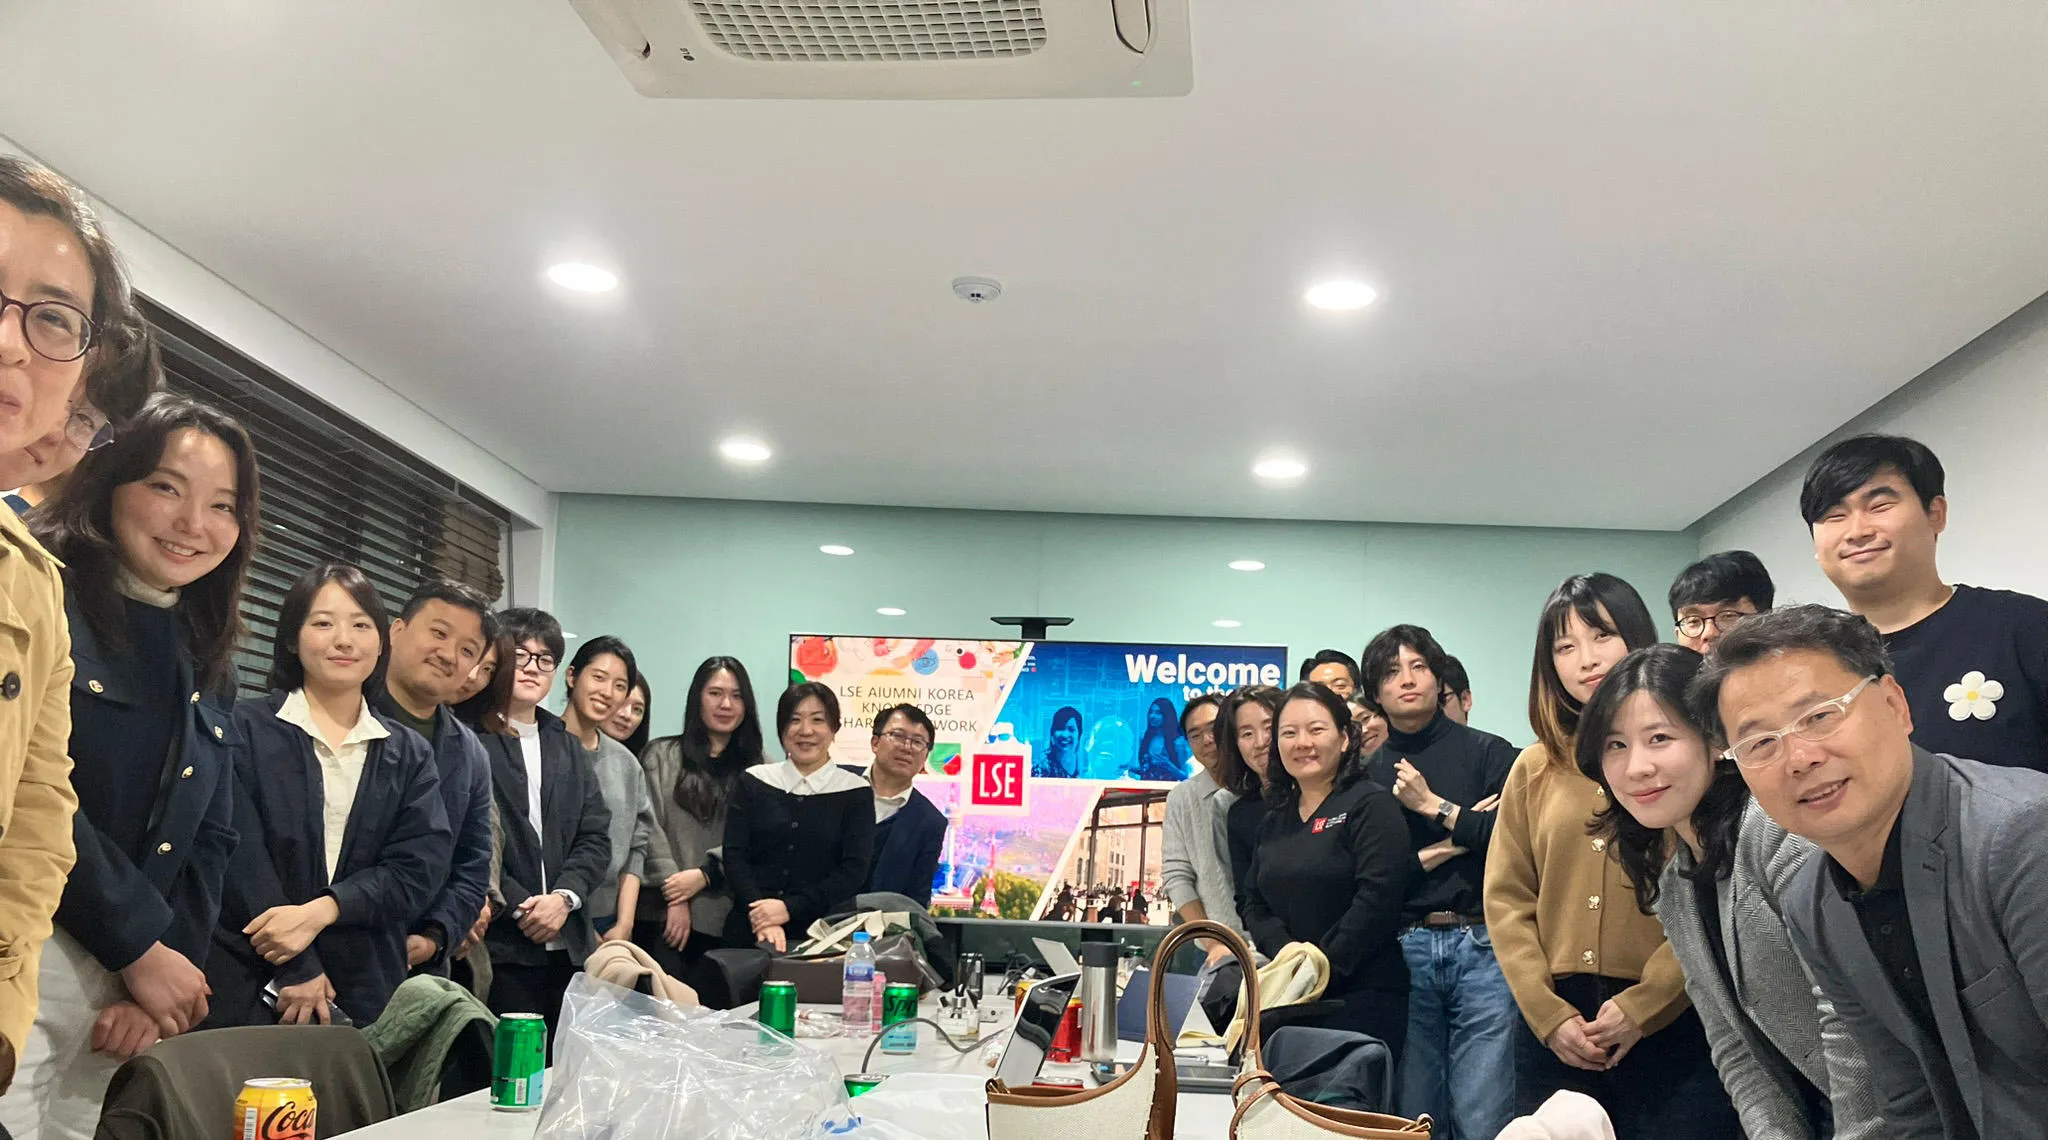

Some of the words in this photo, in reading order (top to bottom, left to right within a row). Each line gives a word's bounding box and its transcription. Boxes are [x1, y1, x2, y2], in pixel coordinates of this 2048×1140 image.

[1125, 654, 1281, 687] Welcome
[840, 686, 862, 698] LSE
[928, 688, 974, 701] KOREA
[1183, 685, 1202, 701] to
[979, 761, 1016, 798] LSE
[262, 1101, 315, 1140] Coca
